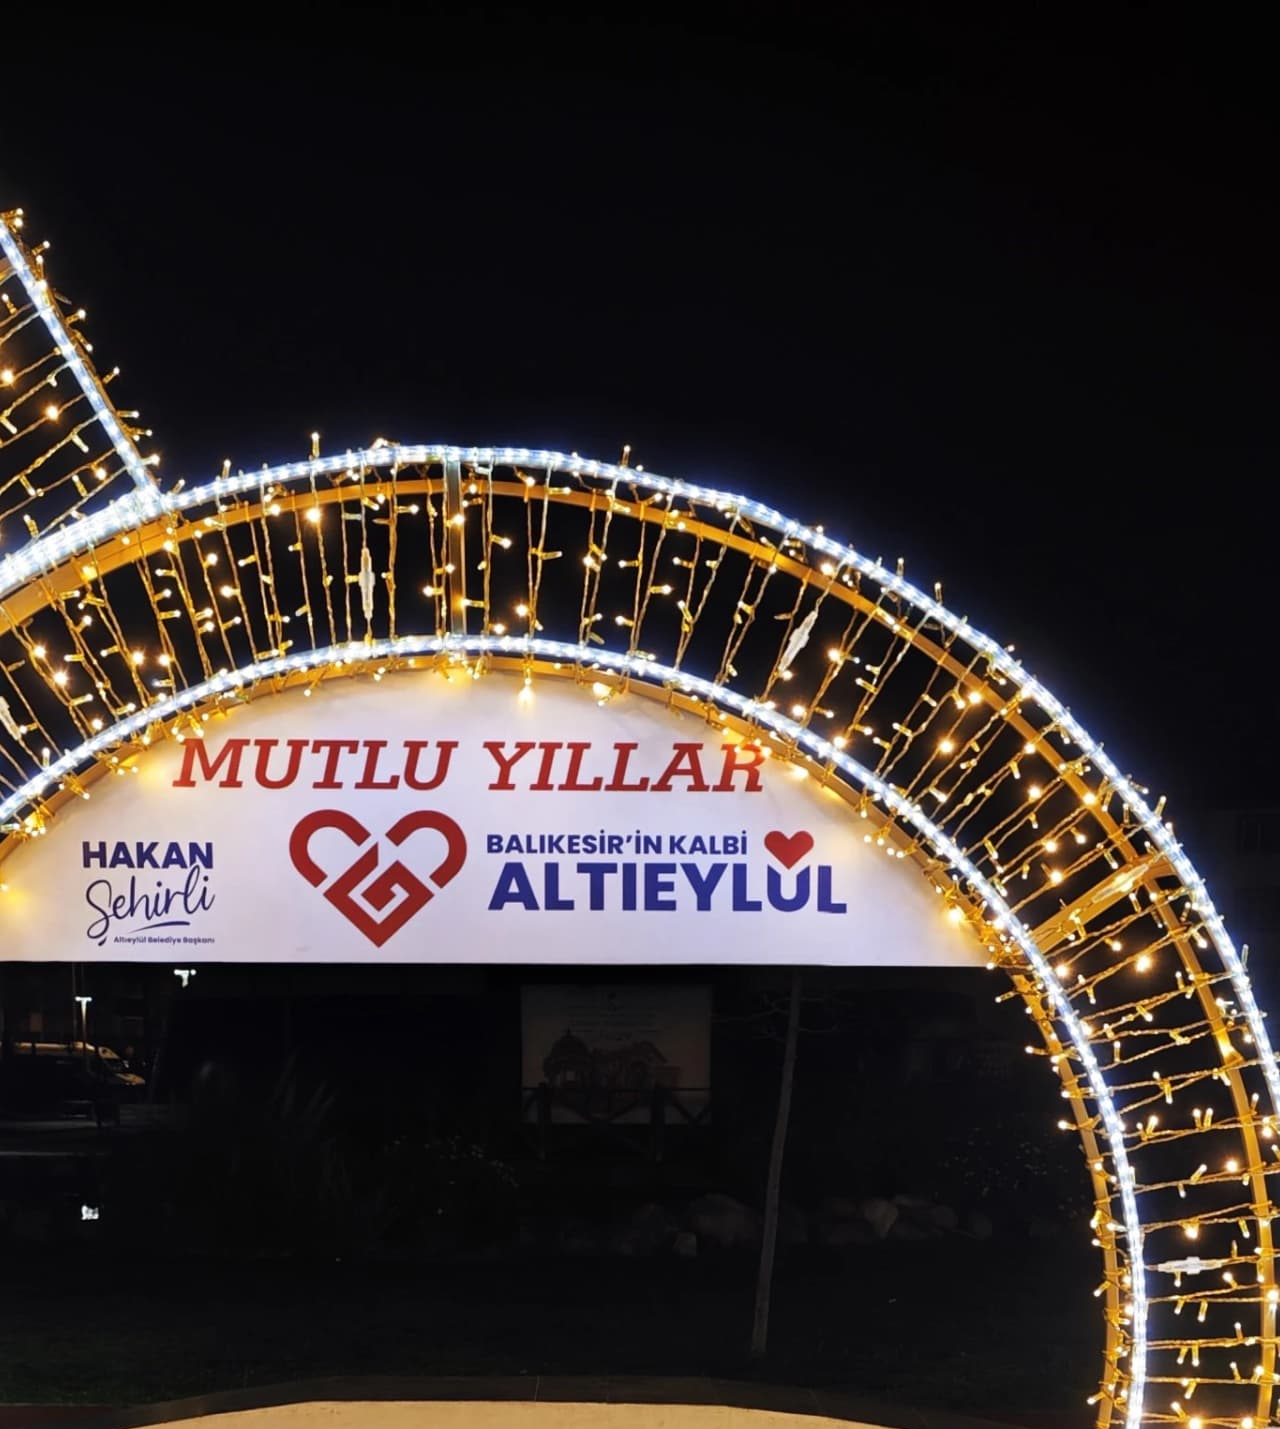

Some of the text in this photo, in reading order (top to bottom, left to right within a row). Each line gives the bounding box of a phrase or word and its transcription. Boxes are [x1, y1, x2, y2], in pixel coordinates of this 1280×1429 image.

[172, 738, 768, 792] MUTLU YILLAR
[82, 841, 214, 869] HAKAN
[669, 830, 748, 855] KALBİ
[86, 865, 216, 946] Şehirli
